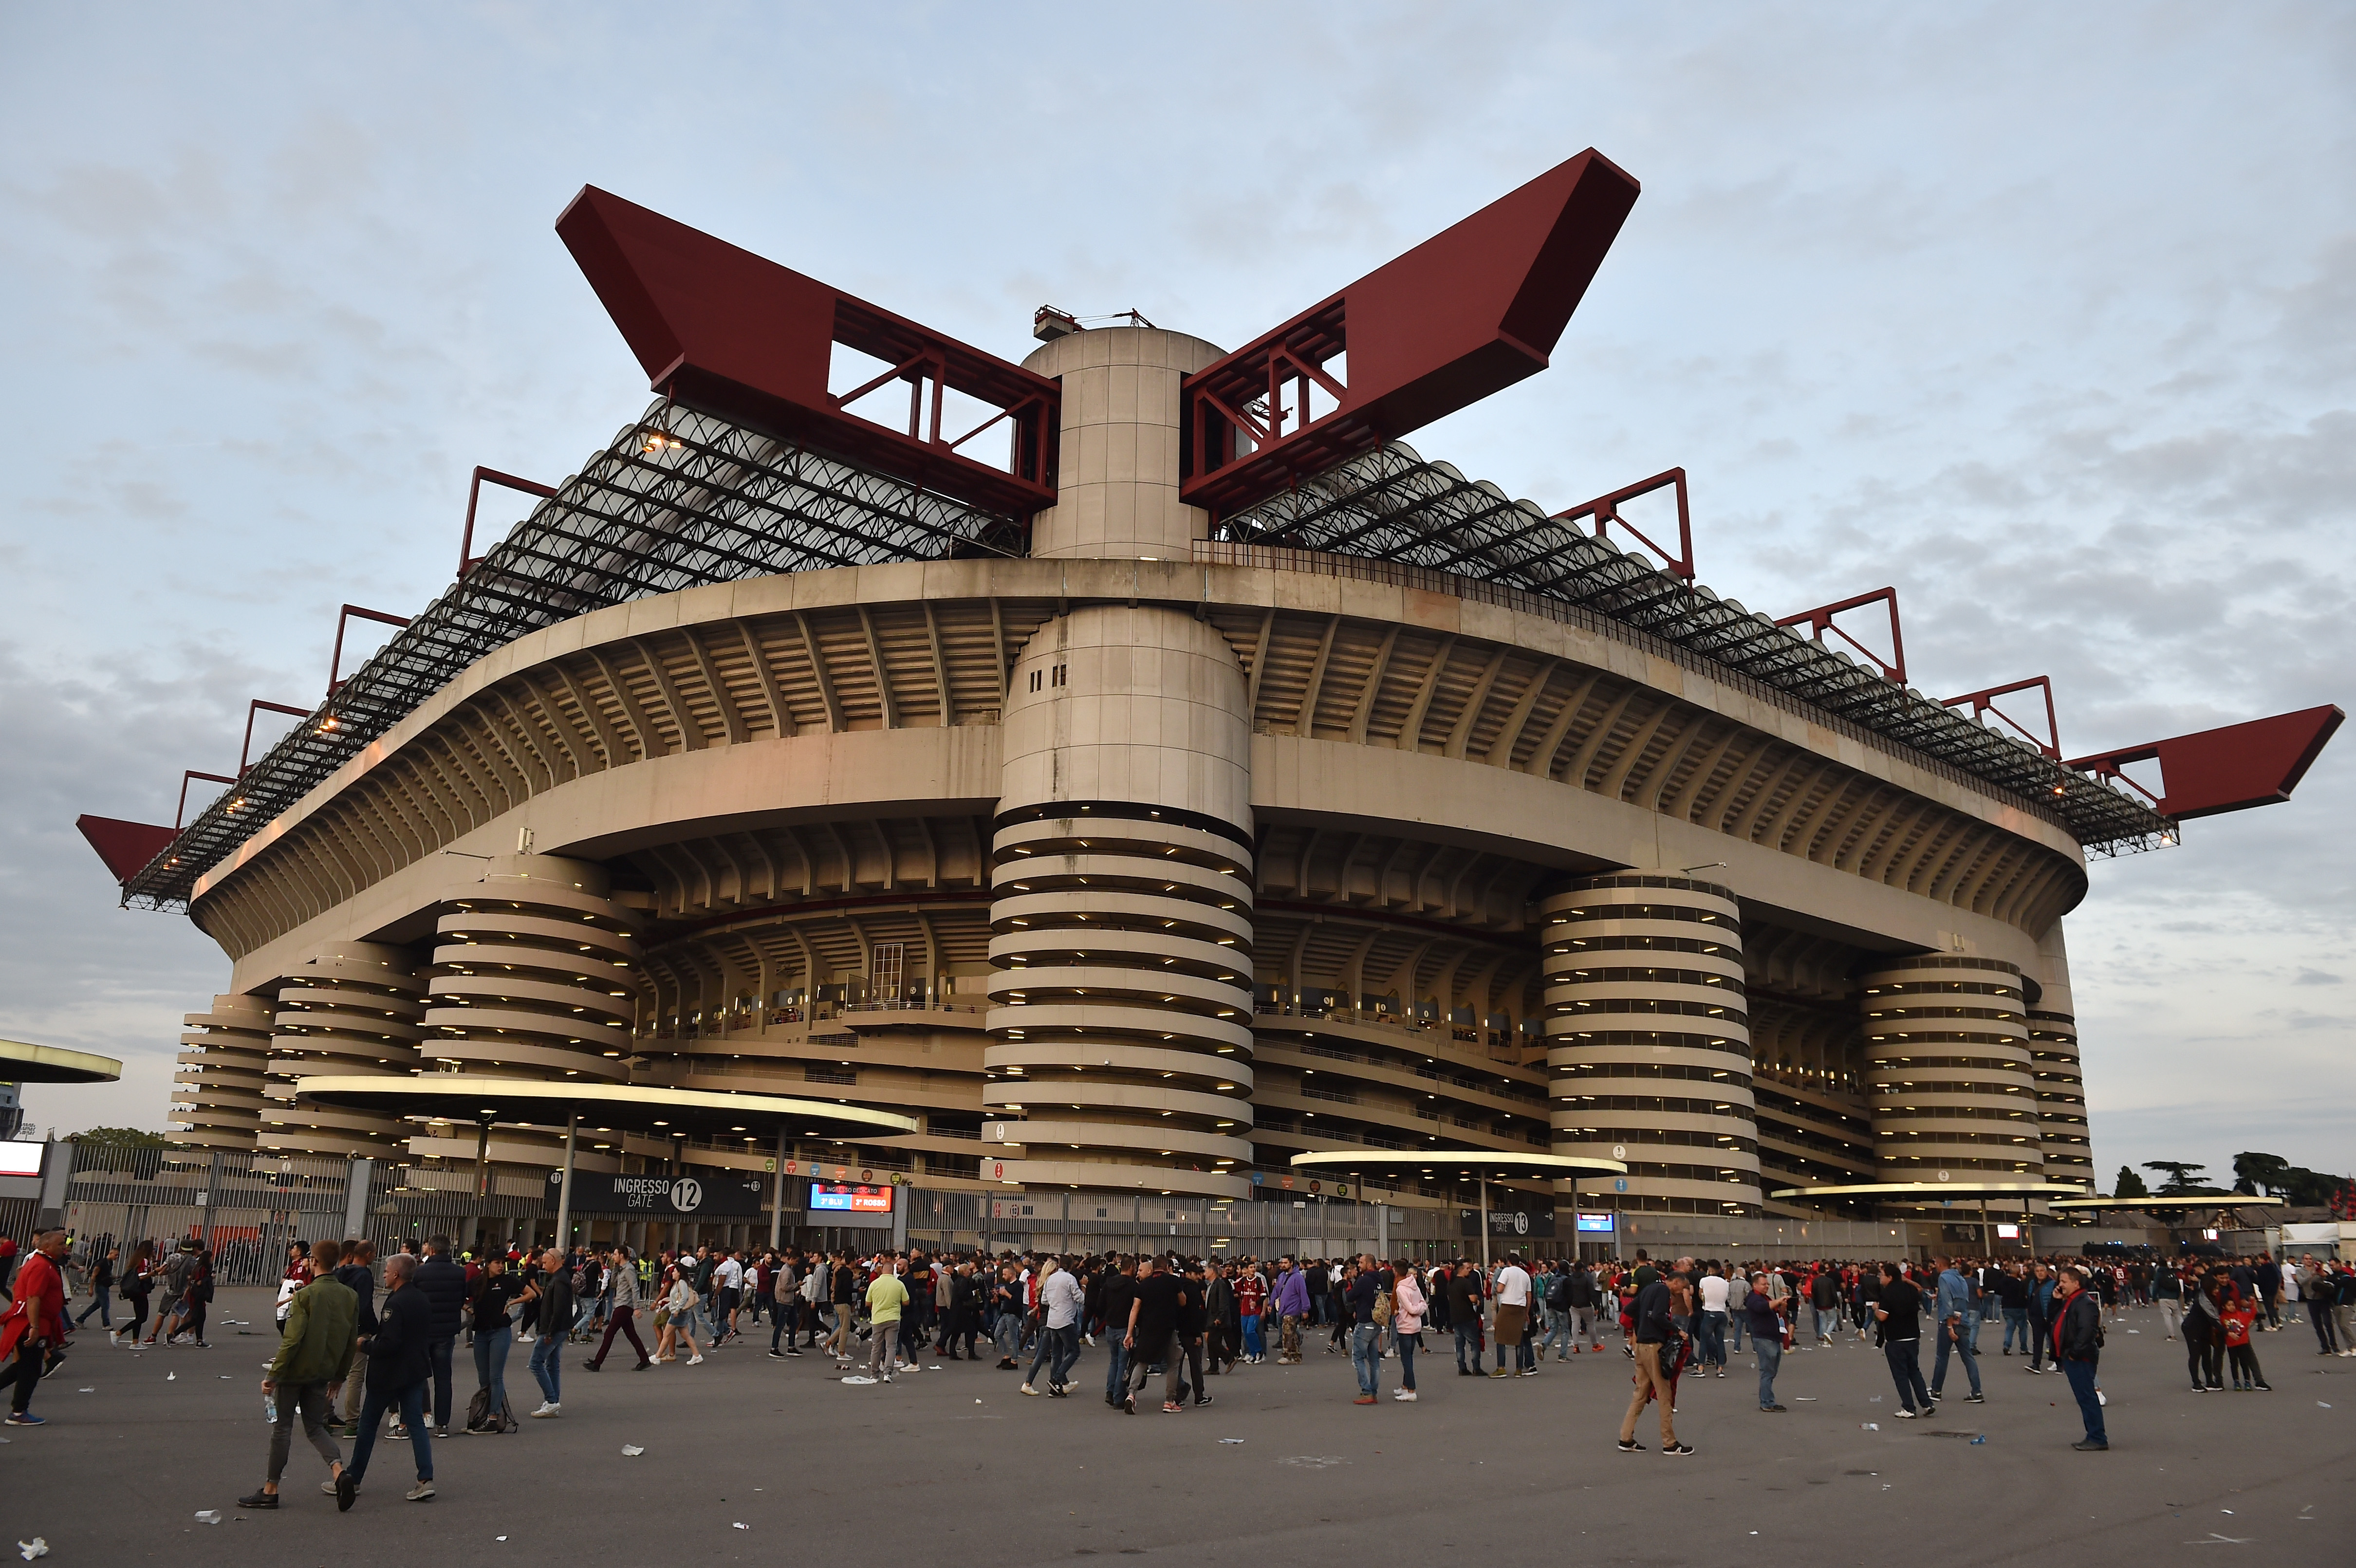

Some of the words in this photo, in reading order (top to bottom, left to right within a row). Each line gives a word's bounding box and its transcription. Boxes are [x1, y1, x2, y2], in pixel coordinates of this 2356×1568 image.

[553, 1174, 560, 1182] 11
[614, 1178, 669, 1195] INGRESSO
[676, 1182, 697, 1207] 12
[628, 1193, 654, 1208] GATE
[1489, 1213, 1514, 1223] INGRESSO
[1517, 1215, 1526, 1231] 13
[1496, 1223, 1507, 1232] GATE
